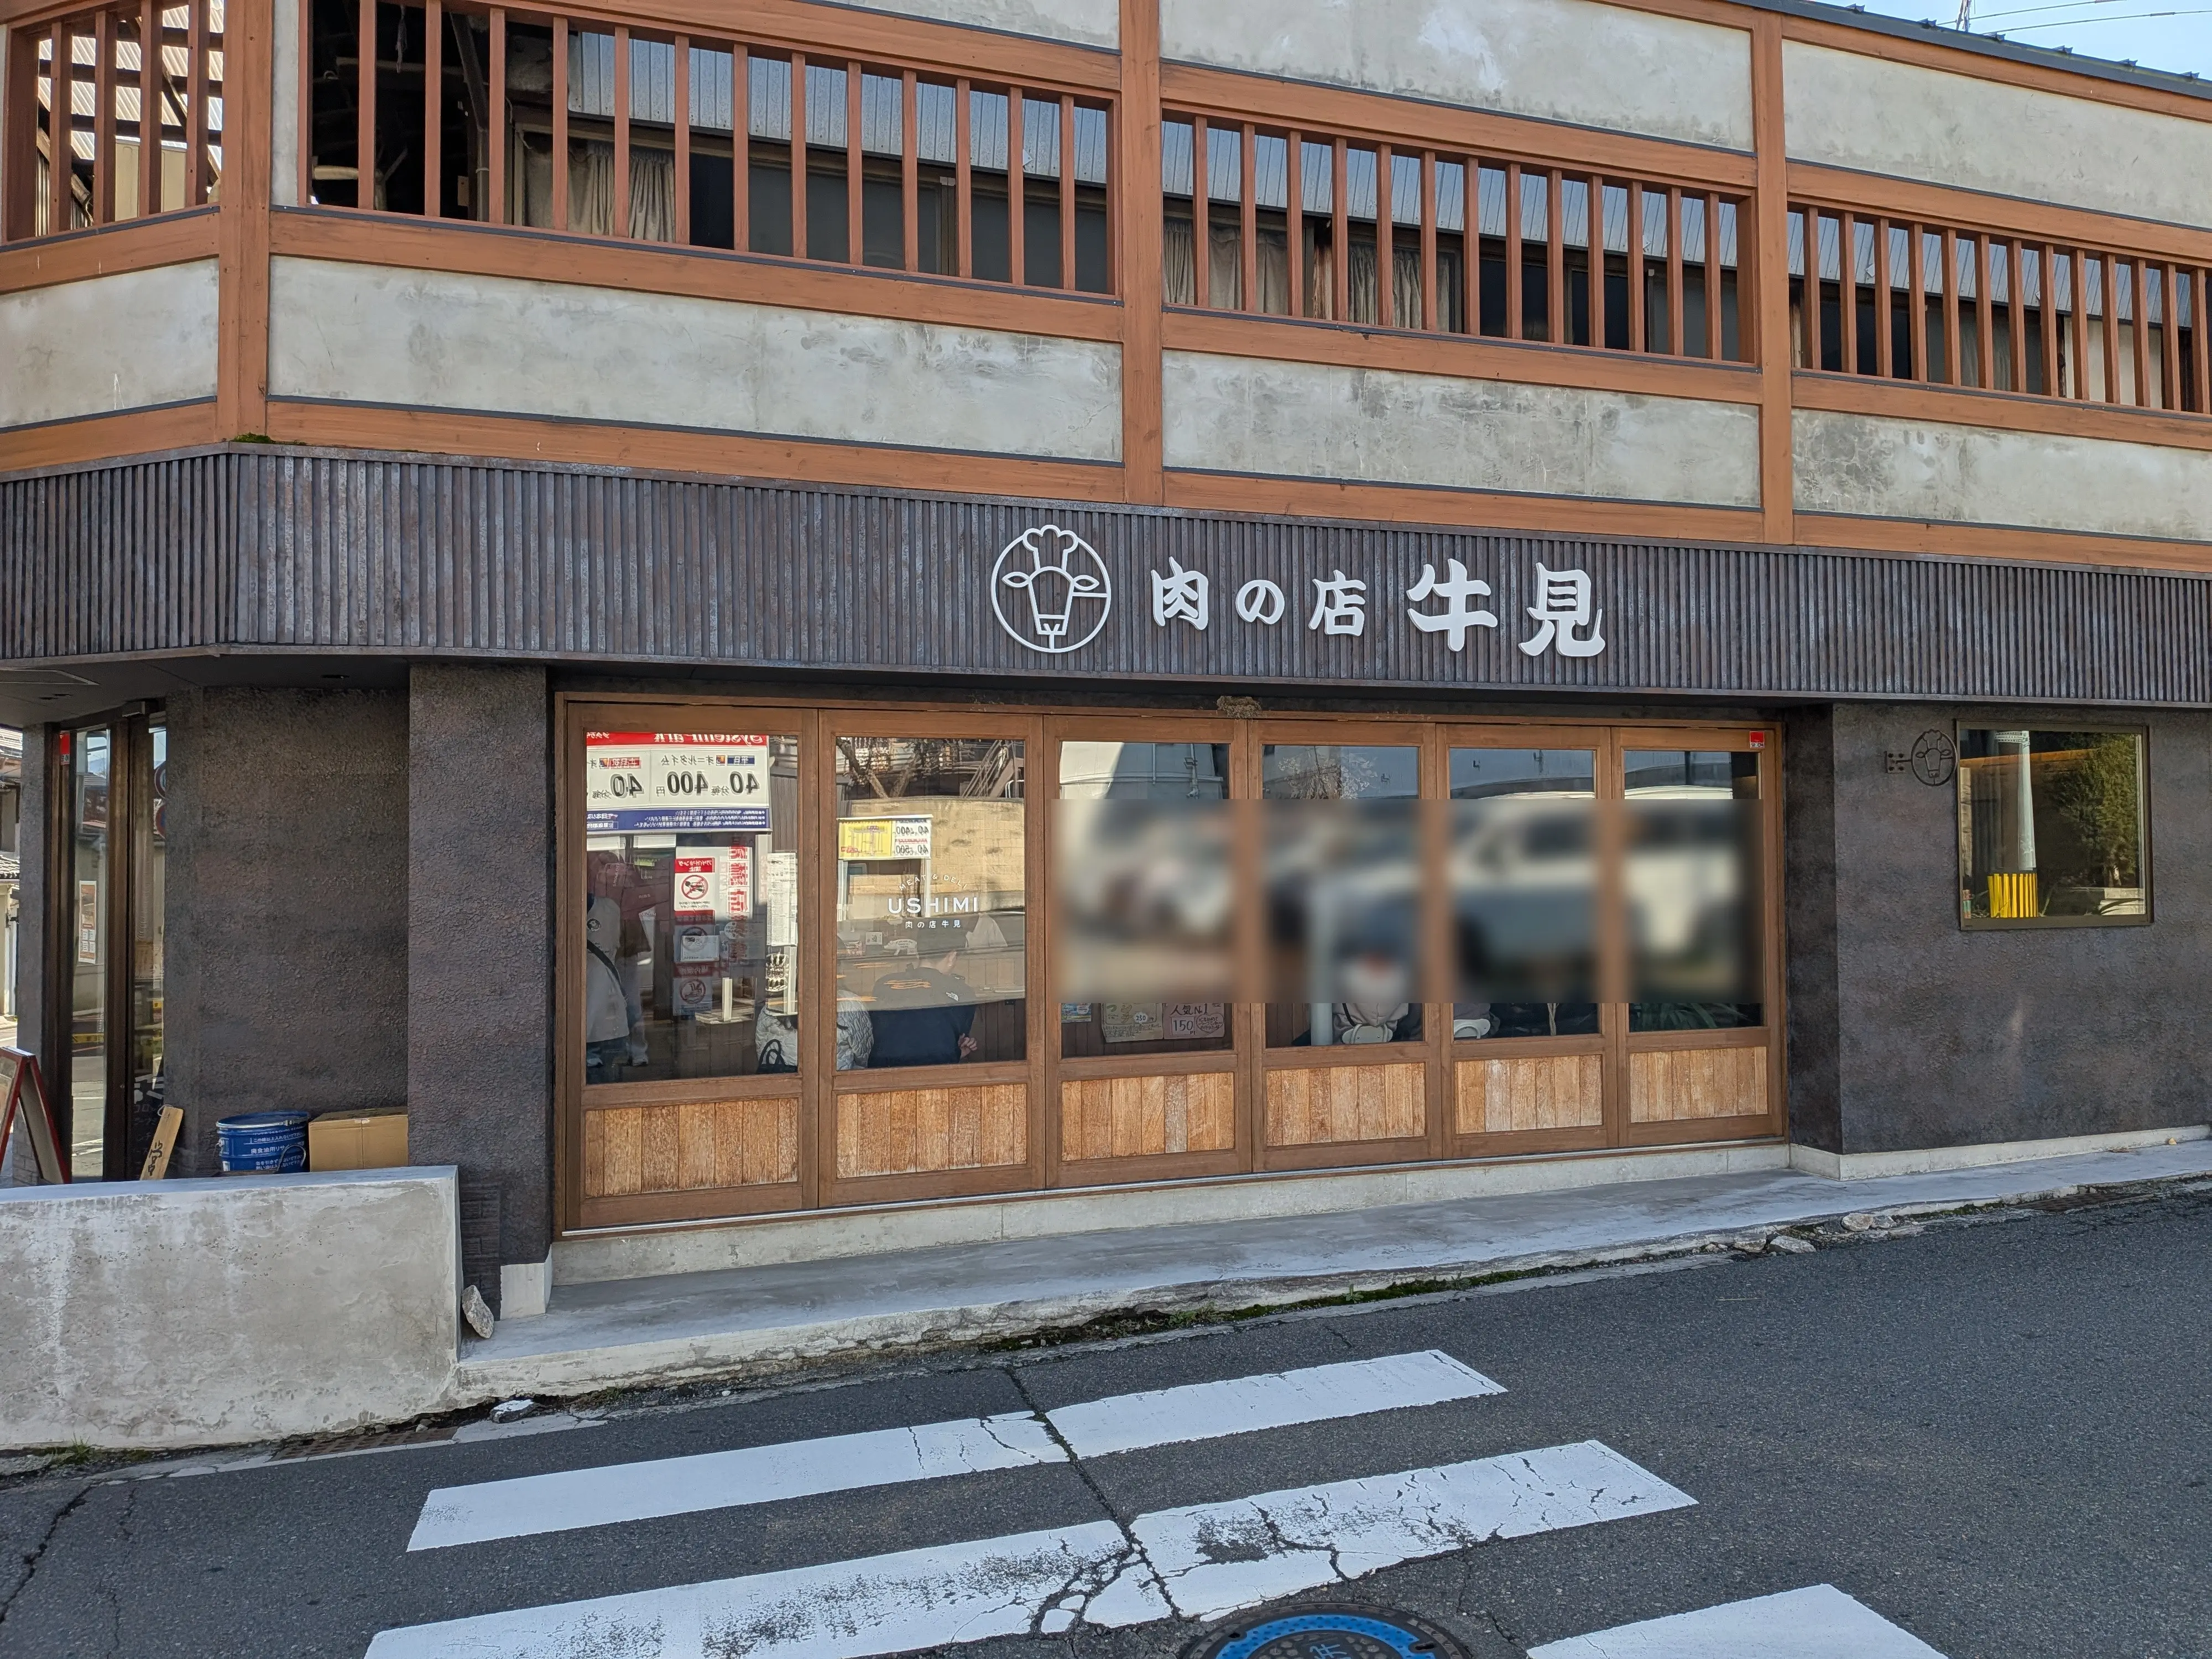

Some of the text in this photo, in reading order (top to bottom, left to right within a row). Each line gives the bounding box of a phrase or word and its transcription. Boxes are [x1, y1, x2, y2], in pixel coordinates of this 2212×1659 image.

[899, 874, 926, 891] MEAT
[943, 874, 968, 890] DELI
[888, 897, 978, 914] USHIMI
